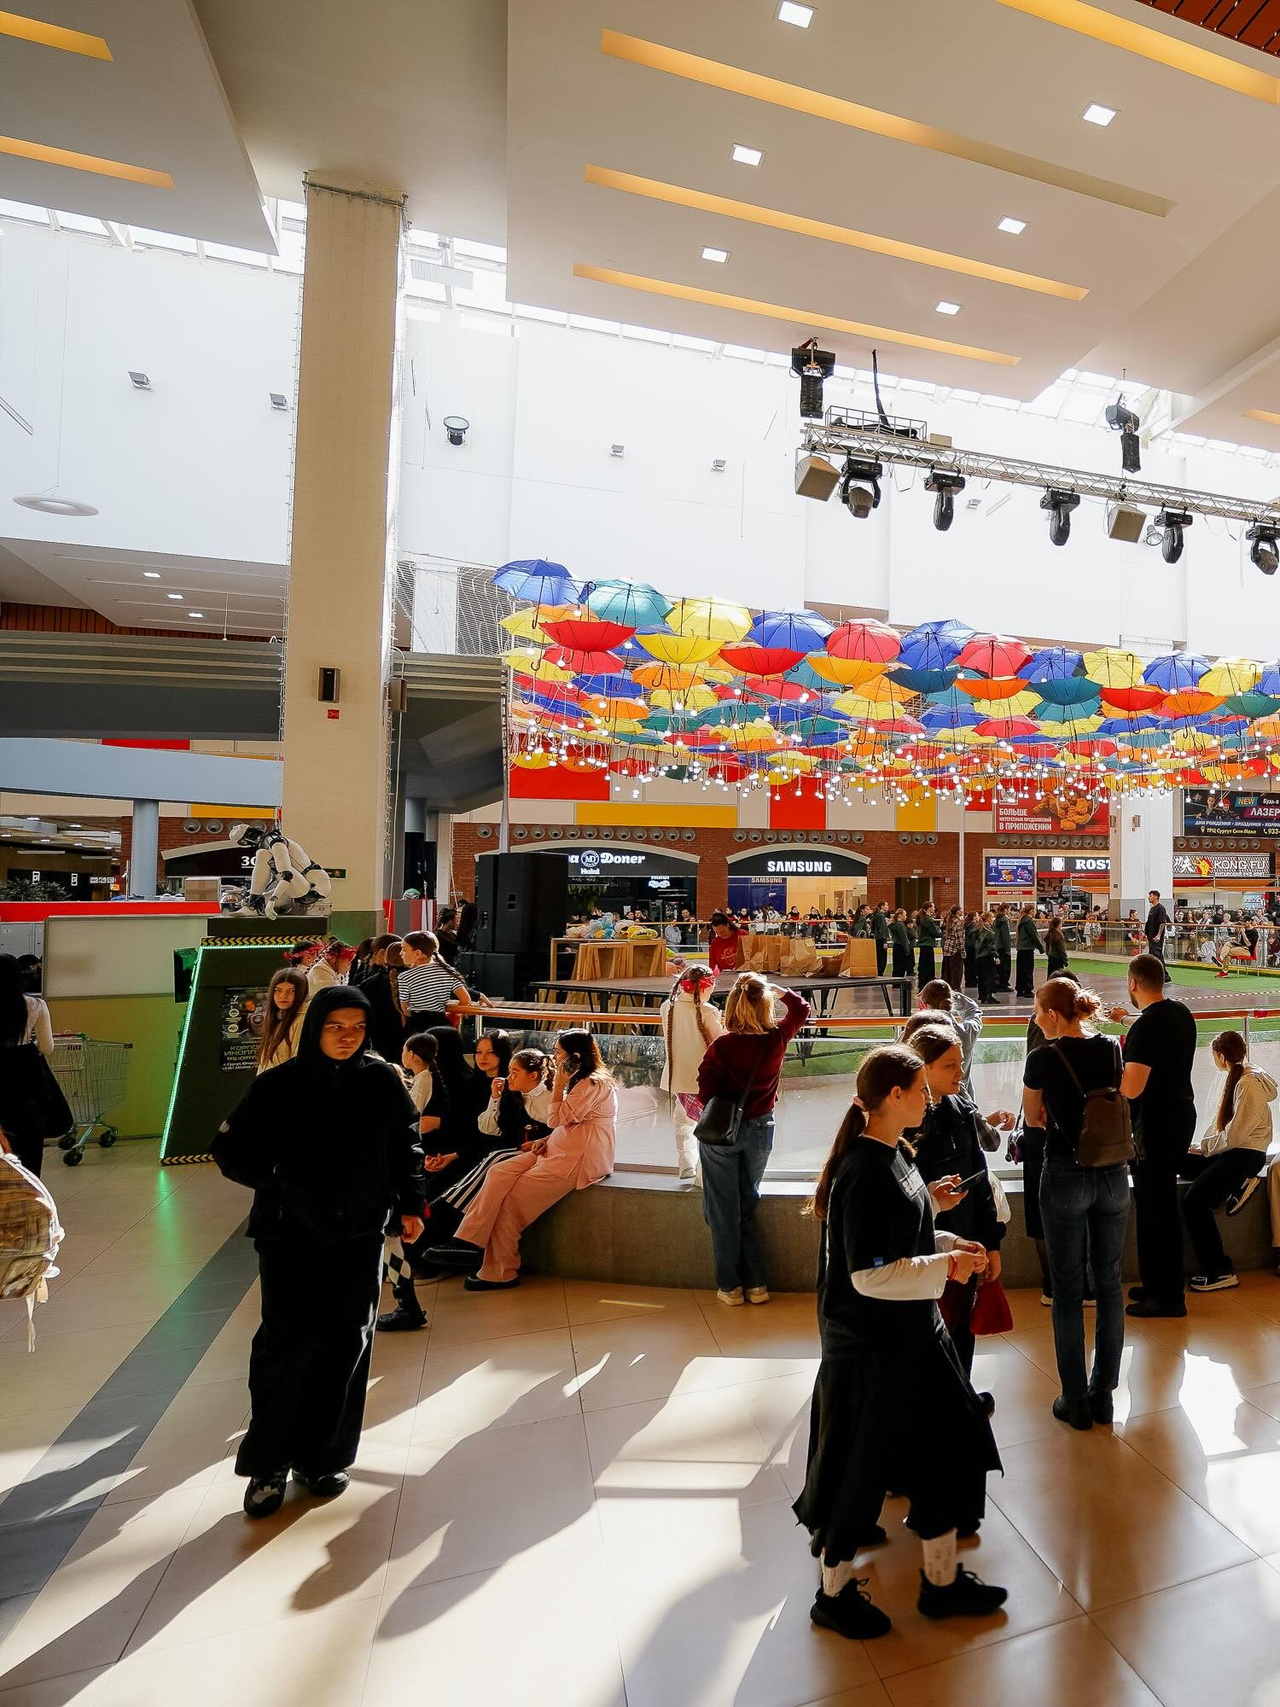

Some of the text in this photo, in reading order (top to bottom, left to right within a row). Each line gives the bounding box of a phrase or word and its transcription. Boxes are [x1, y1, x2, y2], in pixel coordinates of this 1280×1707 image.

[600, 852, 645, 864] Doner
[767, 861, 832, 872] SAMSUNG
[1215, 860, 1265, 869] KONG FU
